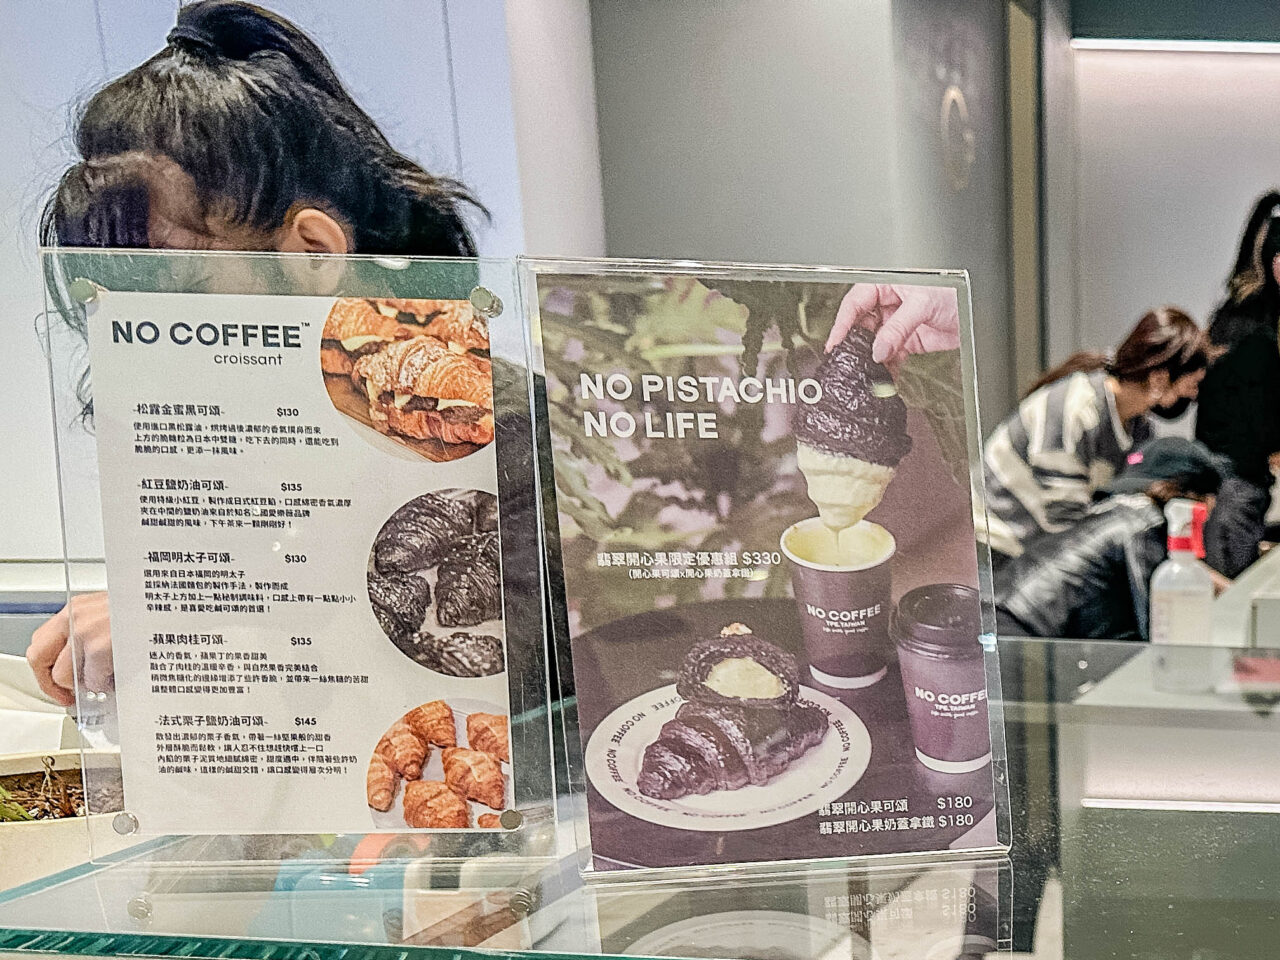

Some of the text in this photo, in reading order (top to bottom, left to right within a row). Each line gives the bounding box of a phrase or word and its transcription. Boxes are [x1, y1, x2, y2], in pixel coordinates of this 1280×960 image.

[112, 320, 160, 344] NO
[169, 321, 302, 348] COFFEE
[213, 352, 283, 366] croissant
[580, 373, 823, 405] NO PISTACHIO
[276, 407, 299, 418] $130
[583, 411, 719, 439] NO LIFE
[280, 482, 303, 492] $135
[284, 554, 307, 564] $130
[742, 553, 781, 566] $330
[806, 603, 881, 622] NO COFFEE
[290, 637, 312, 646] $135
[914, 687, 987, 705] NO COFFE
[294, 717, 317, 727] $145
[818, 799, 909, 817] 翡翠開心果可頌
[937, 796, 973, 810] $180
[938, 813, 974, 828] $180
